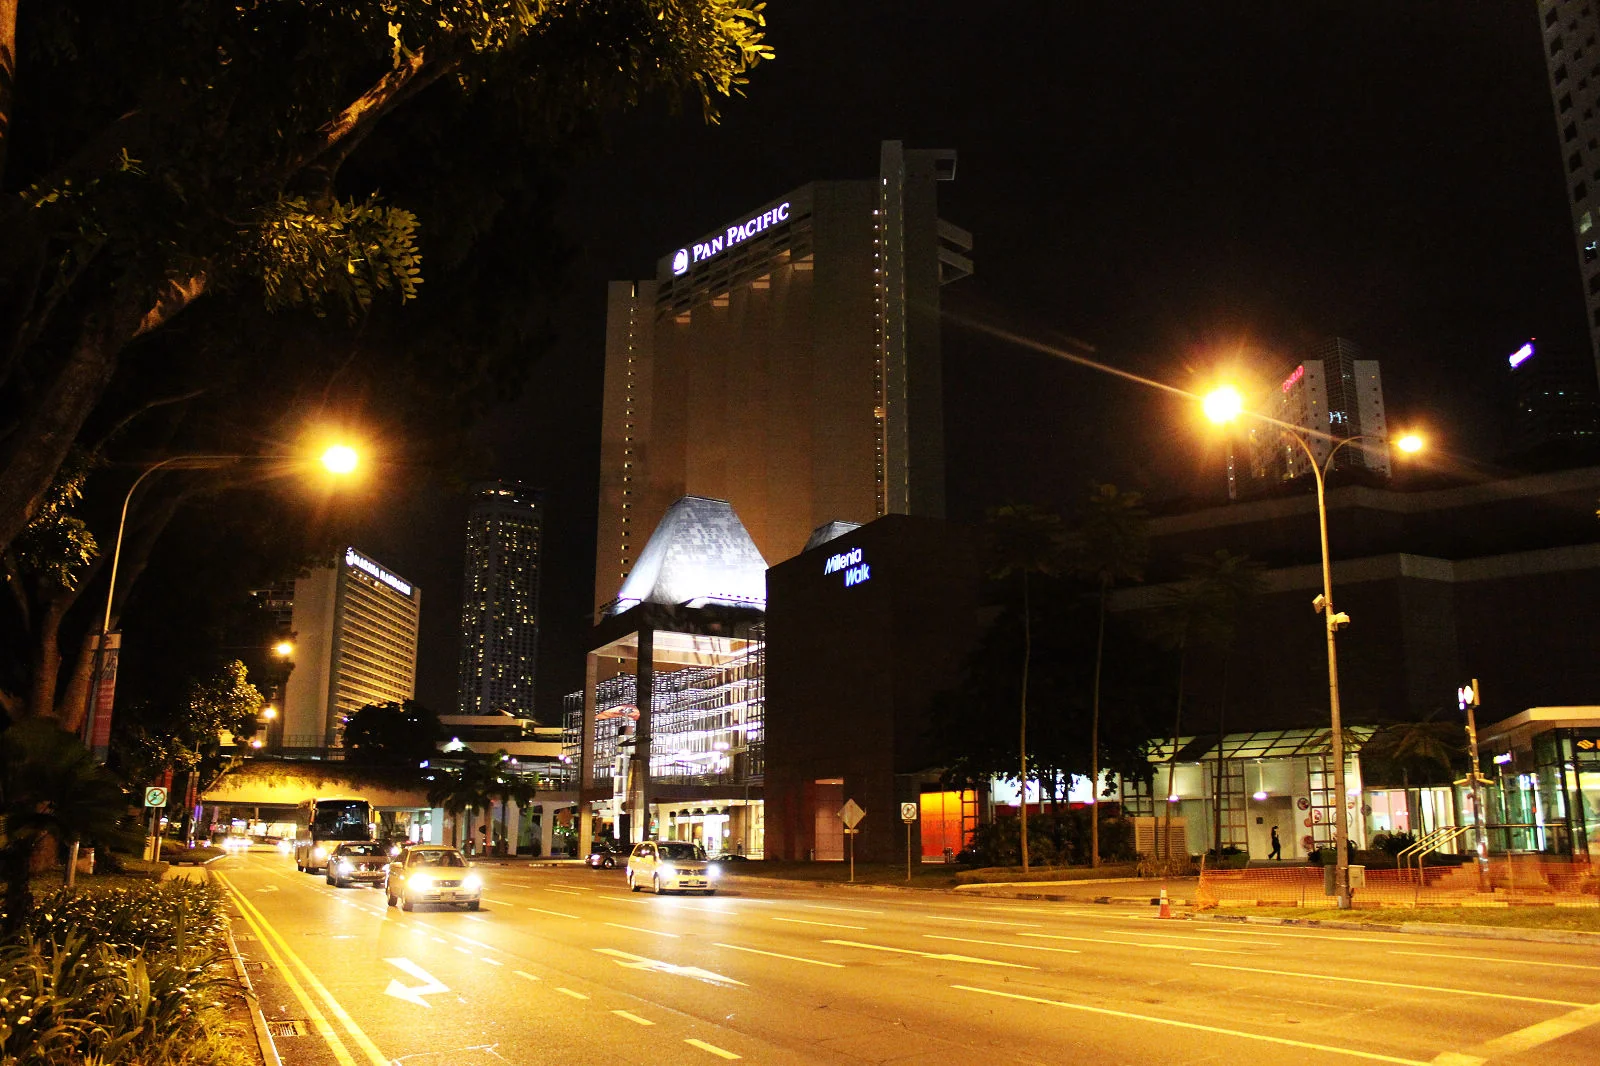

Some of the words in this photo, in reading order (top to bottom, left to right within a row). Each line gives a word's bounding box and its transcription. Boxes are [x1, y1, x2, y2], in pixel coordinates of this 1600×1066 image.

[692, 235, 723, 262] PAN
[726, 202, 790, 247] PACIFIC
[824, 547, 862, 576] Millenia
[845, 563, 870, 587] Walk
